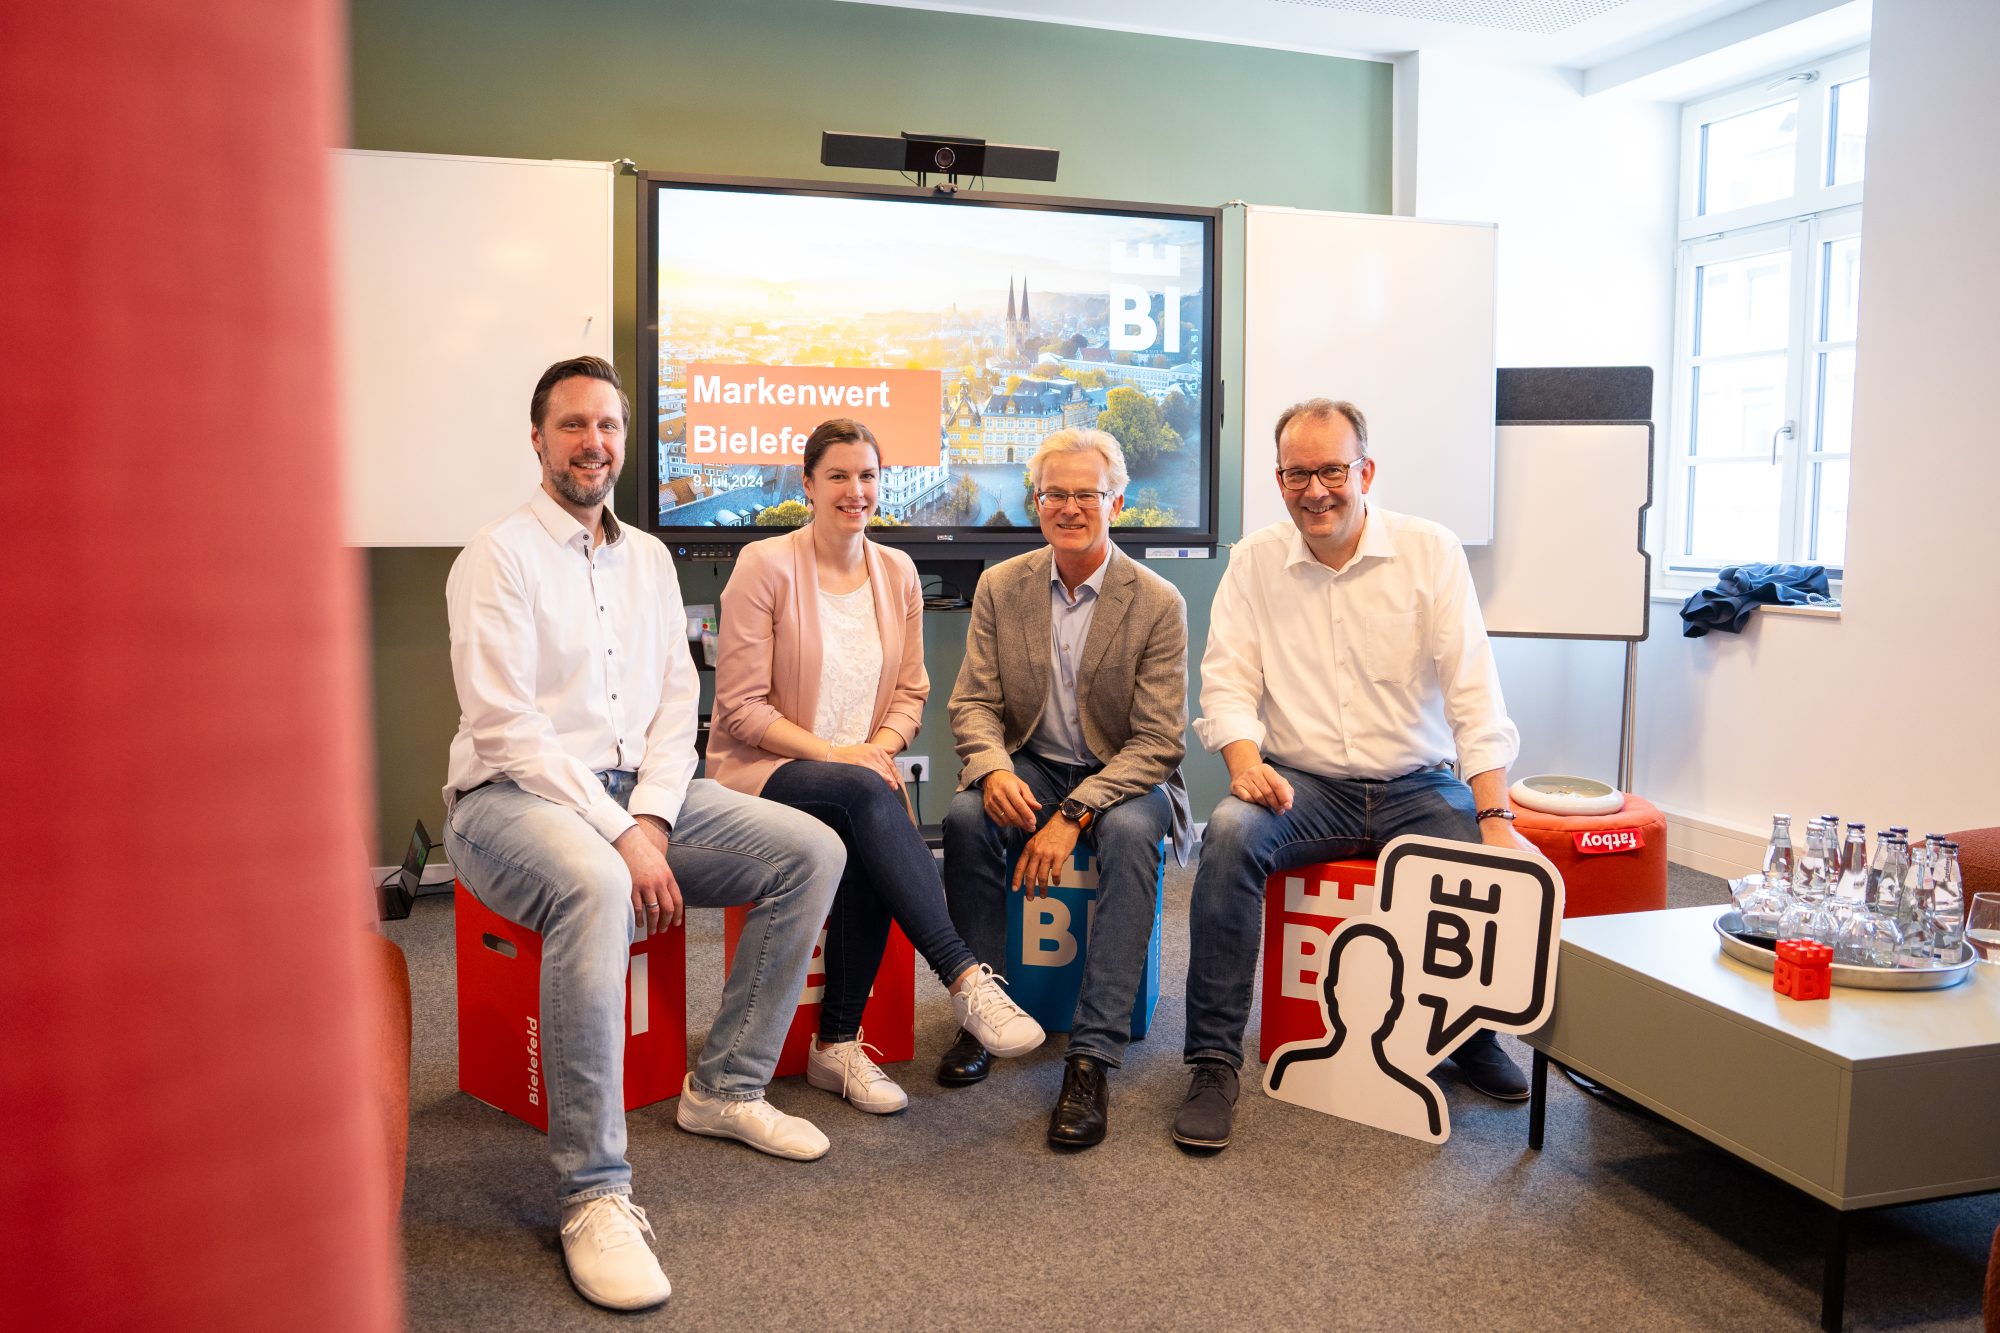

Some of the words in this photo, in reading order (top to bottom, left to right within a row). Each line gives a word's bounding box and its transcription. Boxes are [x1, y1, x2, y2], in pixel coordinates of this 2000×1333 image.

[693, 375, 890, 408] Markenwert
[693, 425, 816, 455] Bielefe
[731, 475, 764, 488] 2024
[1581, 832, 1636, 850] fatboy
[1281, 922, 1330, 1002] B
[1422, 909, 1498, 987] BI
[526, 1016, 539, 1106] Bielefeld
